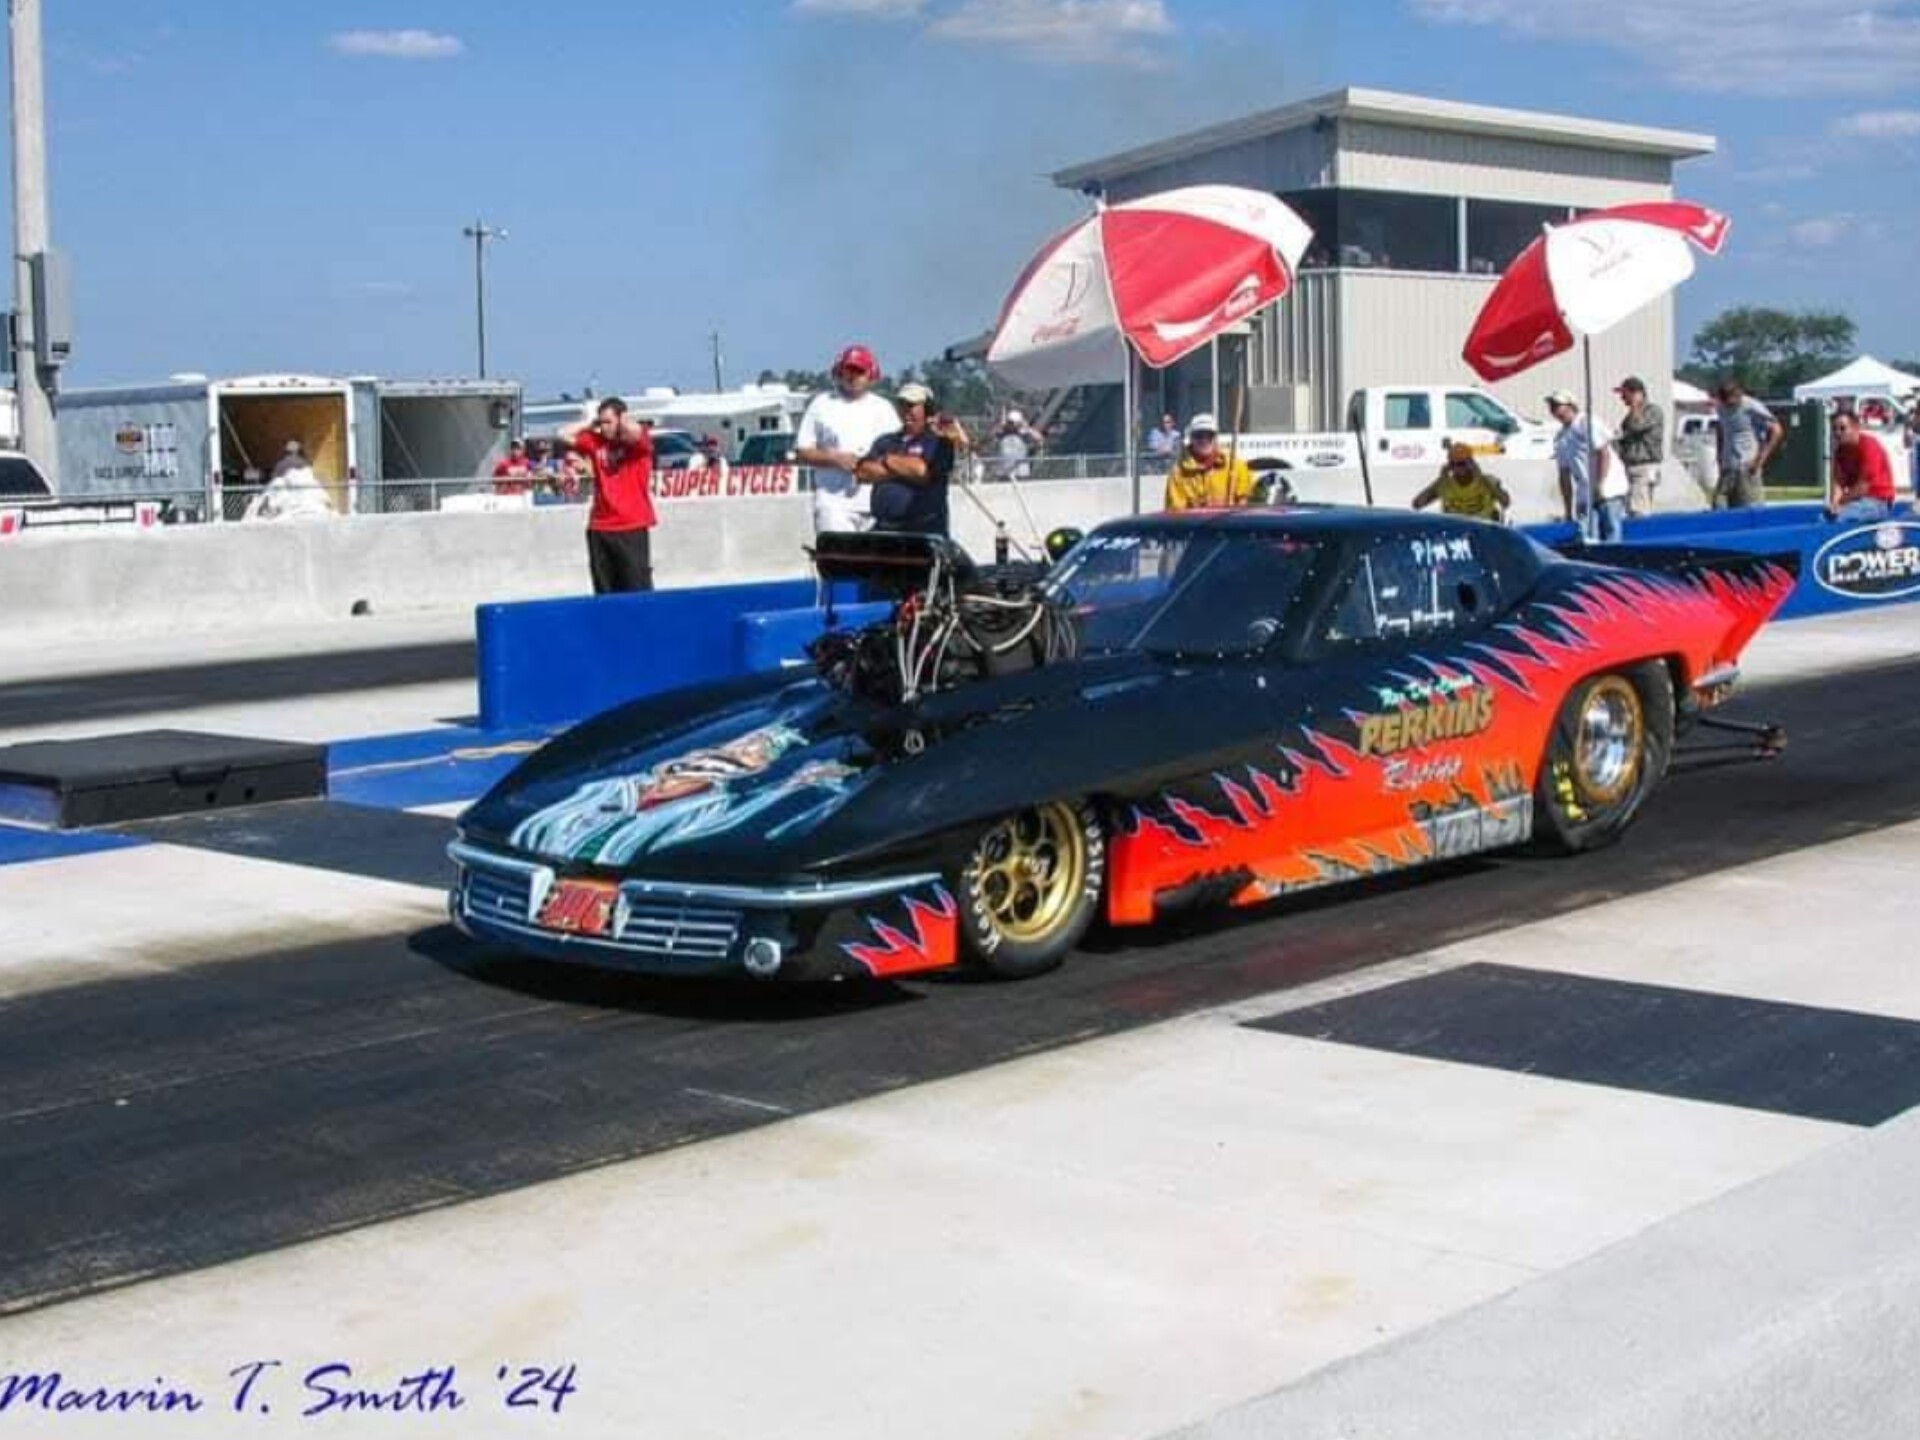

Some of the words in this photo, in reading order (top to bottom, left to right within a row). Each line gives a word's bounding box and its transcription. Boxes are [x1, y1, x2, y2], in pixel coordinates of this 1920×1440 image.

[661, 468, 720, 497] SUPER
[726, 464, 793, 496] CYCLES
[1359, 686, 1495, 757] PERKINS
